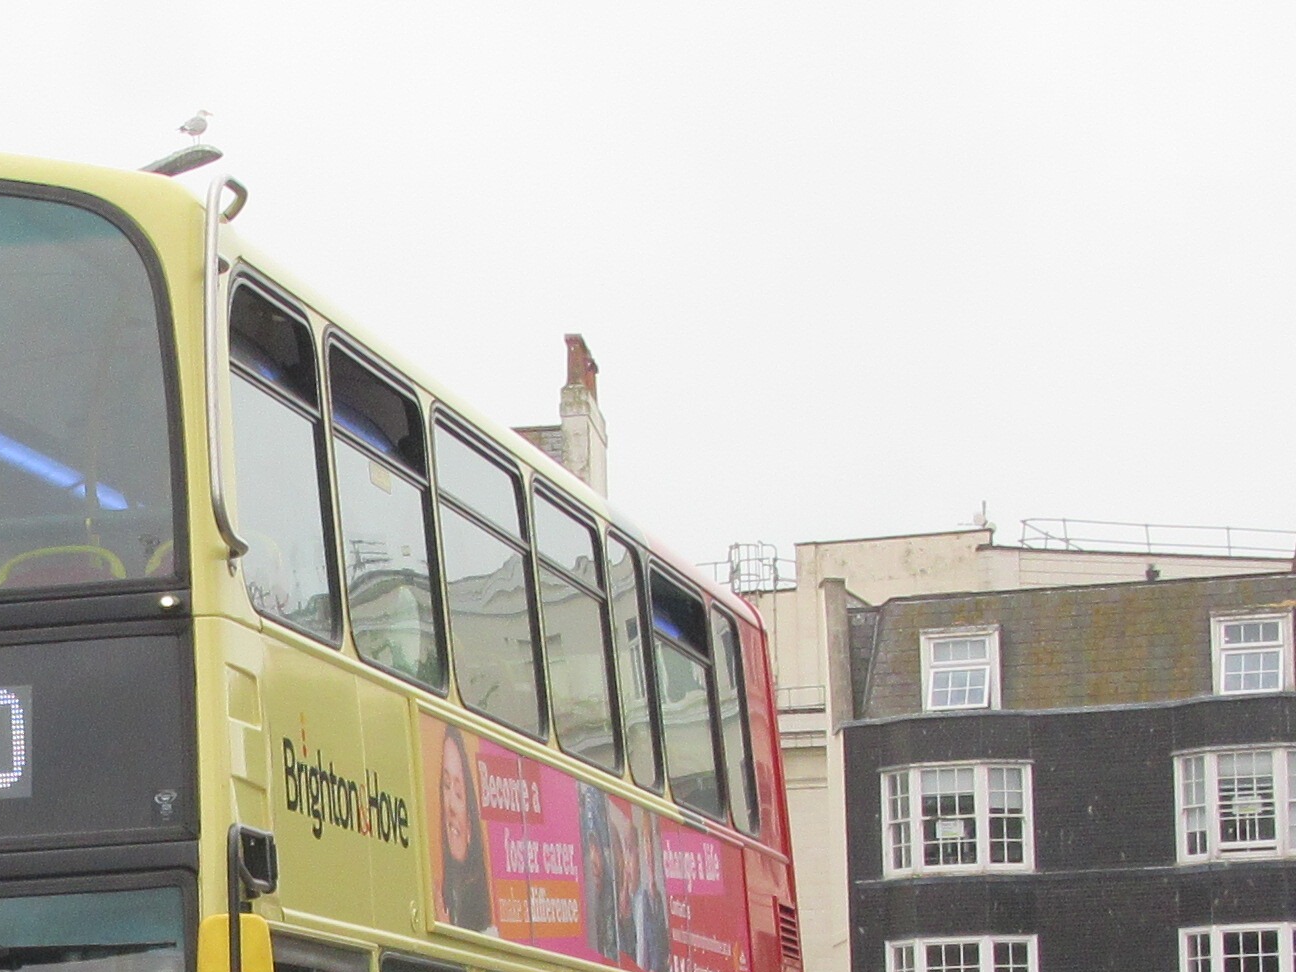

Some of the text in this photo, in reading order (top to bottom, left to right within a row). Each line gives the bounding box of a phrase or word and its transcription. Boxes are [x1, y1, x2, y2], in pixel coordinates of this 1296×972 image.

[478, 760, 541, 813] Become a
[504, 827, 540, 873] foster
